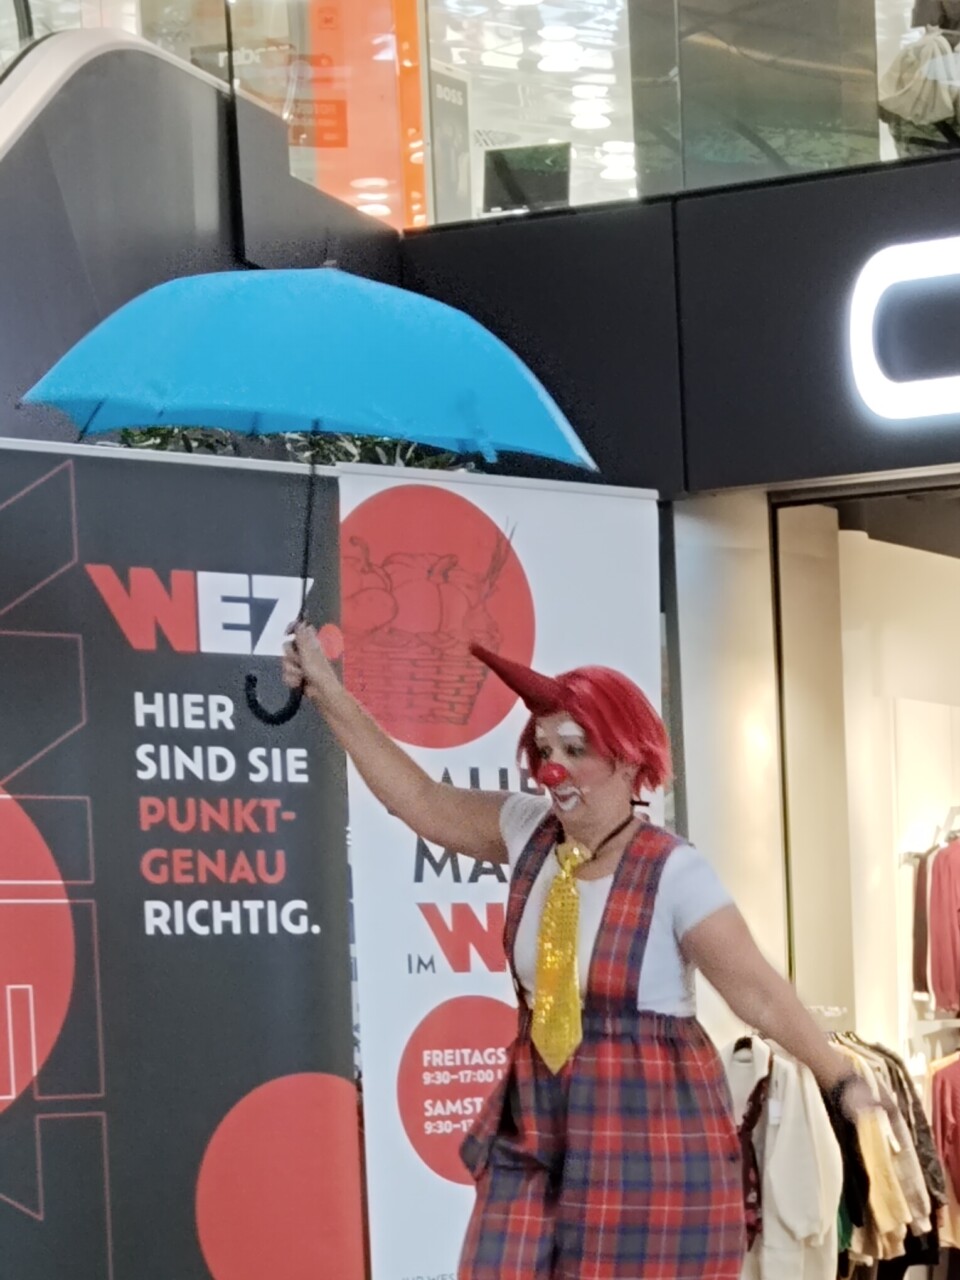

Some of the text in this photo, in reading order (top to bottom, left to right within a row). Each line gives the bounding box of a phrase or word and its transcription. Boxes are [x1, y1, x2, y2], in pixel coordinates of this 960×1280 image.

[84, 564, 314, 656] WEZ
[134, 691, 235, 730] HIER
[135, 744, 309, 783] SIND SIE
[139, 796, 296, 833] PUNKT-
[140, 848, 286, 884] GENAU
[144, 899, 321, 935] RICHTIG.
[408, 953, 436, 974] IM
[423, 1047, 507, 1067] FREITAGS
